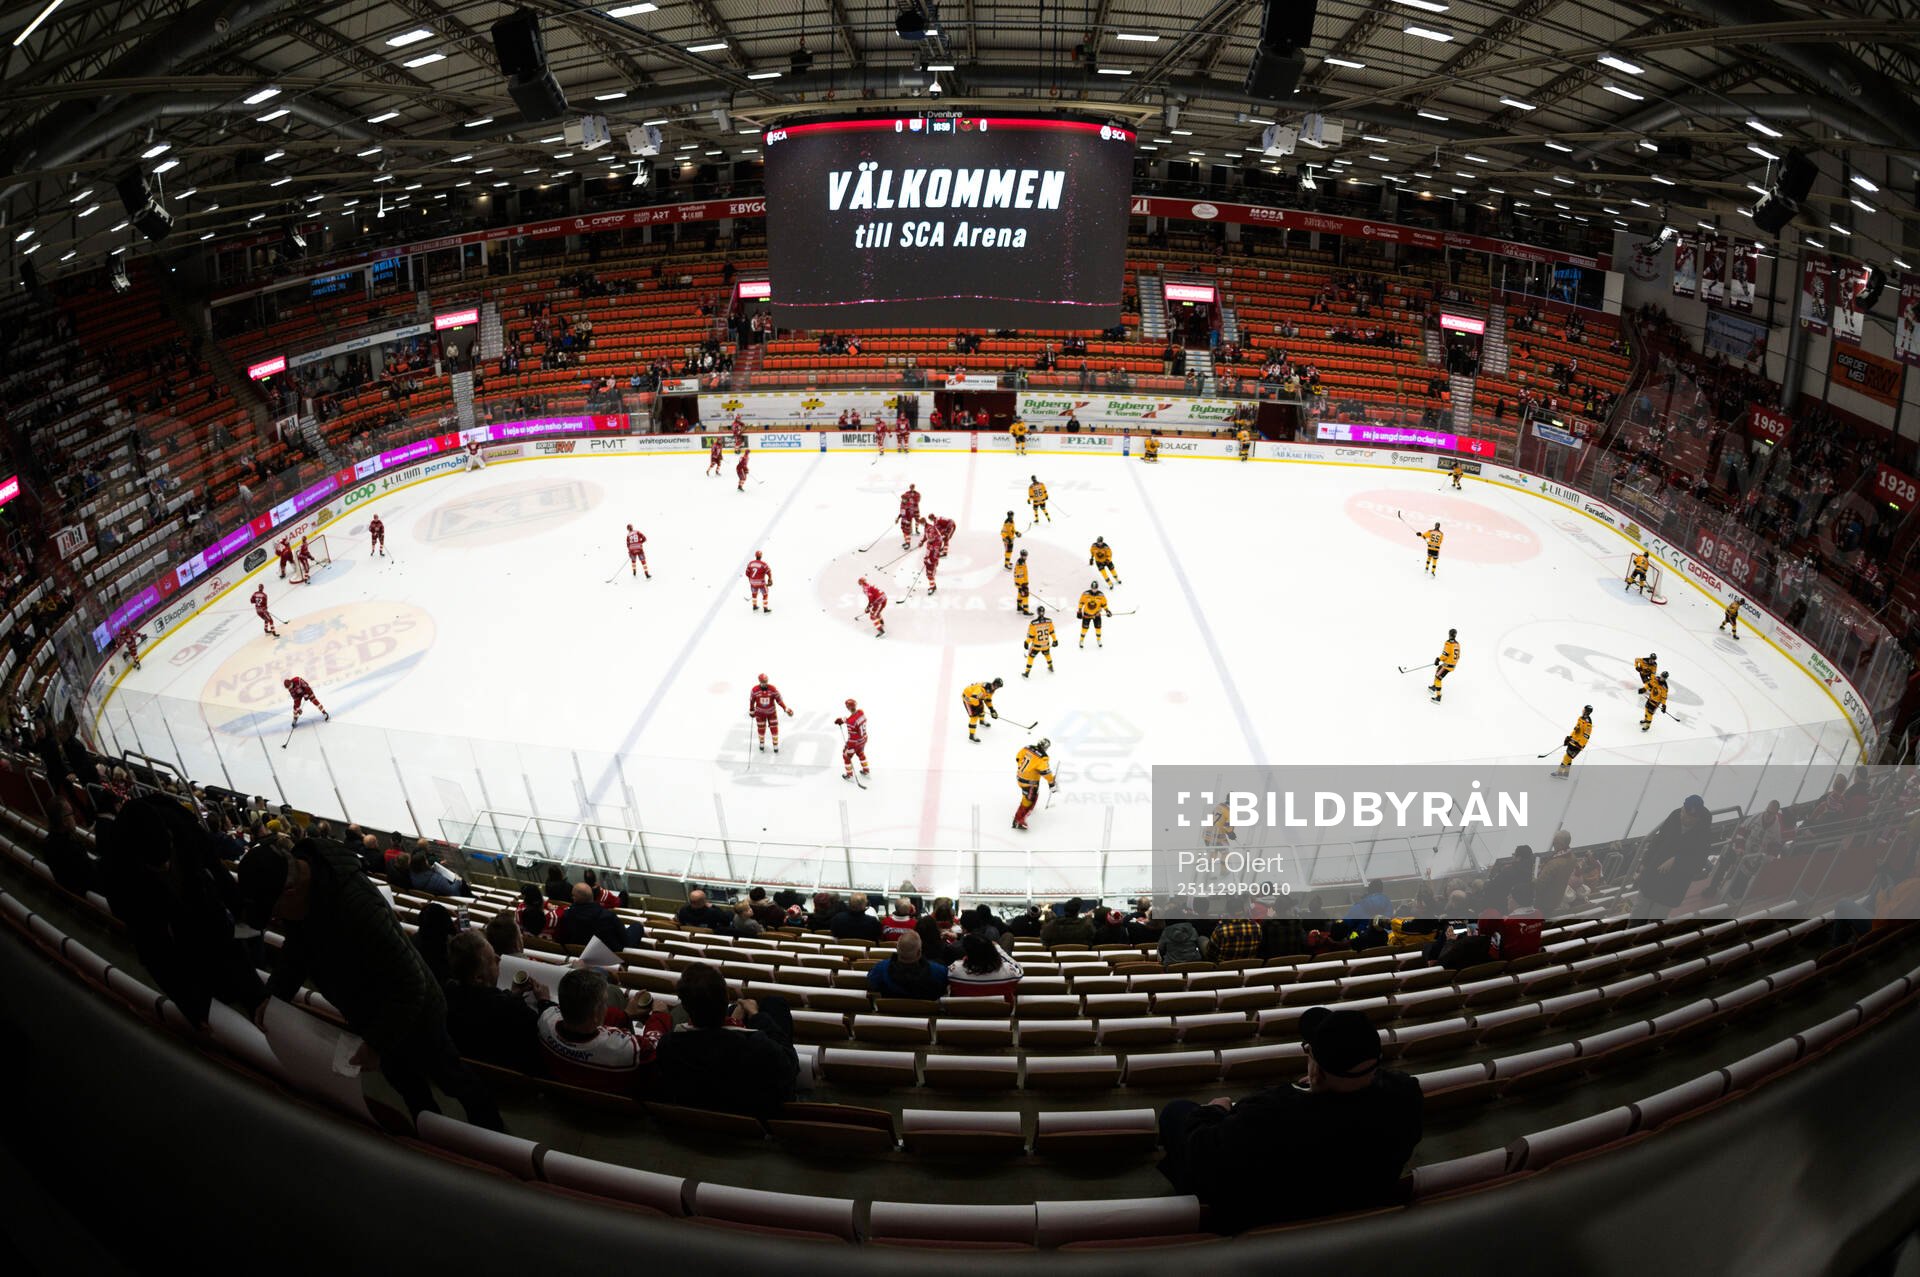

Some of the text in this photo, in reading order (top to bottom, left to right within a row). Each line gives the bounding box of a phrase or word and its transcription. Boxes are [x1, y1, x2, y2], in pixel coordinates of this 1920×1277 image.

[895, 120, 903, 133] 0
[979, 119, 988, 132] 0
[773, 131, 788, 141] SCA
[1111, 129, 1126, 141] SCA
[828, 161, 1065, 210] VÄLKOMMEN
[854, 221, 1027, 248] till SCA Arena
[1024, 399, 1072, 410] Byberg
[1107, 401, 1155, 411] Byberg
[1190, 404, 1236, 415] Byberg
[1753, 412, 1785, 437] 1962
[591, 439, 626, 448] PMT
[842, 433, 870, 443] IMPACT
[1067, 437, 1107, 445] PEAB
[1399, 455, 1423, 466] sprent
[1878, 471, 1916, 502] 1928
[344, 483, 376, 505] coop
[1549, 484, 1580, 504] LILIUM
[1585, 504, 1615, 525] Faradium
[1699, 536, 1714, 559] 19
[1688, 562, 1722, 593] BORGA
[1037, 629, 1049, 642] 25
[216, 612, 417, 697] NORRLANDS
[238, 636, 398, 704] GULD
[1058, 762, 1156, 784] SCA
[1063, 792, 1152, 806] ARENA
